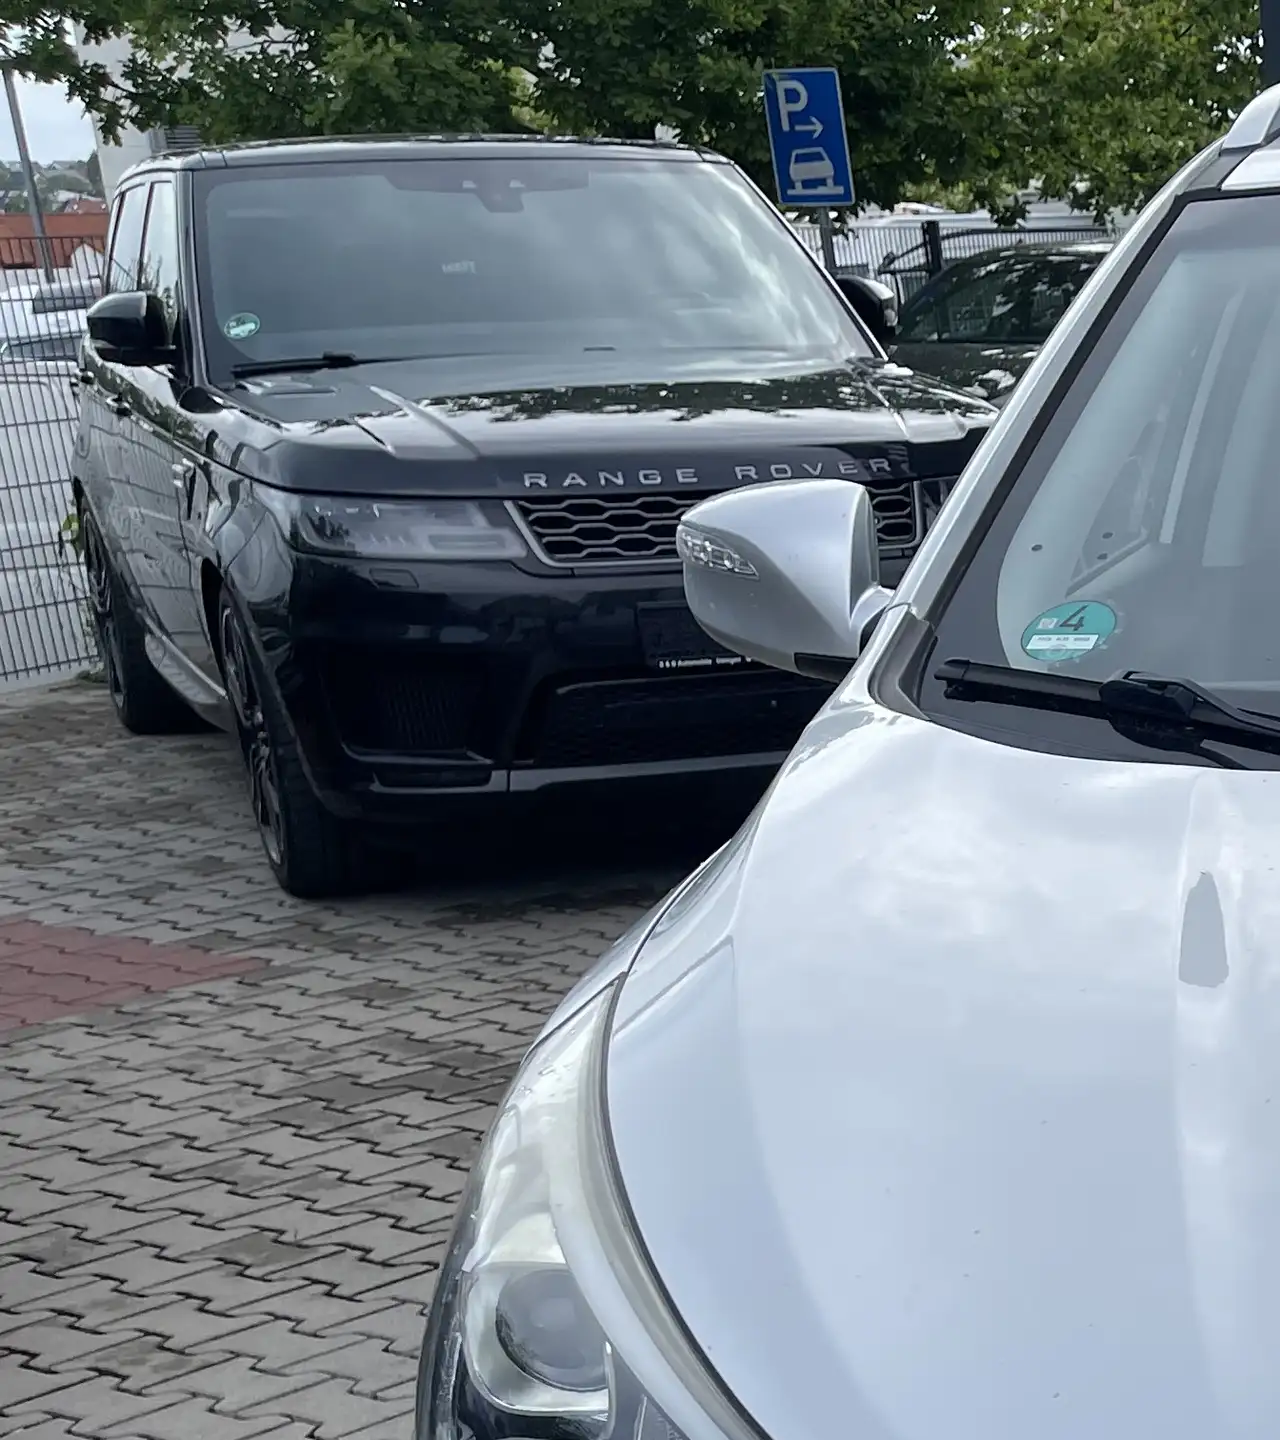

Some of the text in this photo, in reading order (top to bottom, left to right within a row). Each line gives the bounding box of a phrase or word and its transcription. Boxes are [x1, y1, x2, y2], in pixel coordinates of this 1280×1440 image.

[776, 79, 809, 132] P
[523, 457, 892, 488] RANGE ROVER
[1058, 603, 1090, 632] 4
